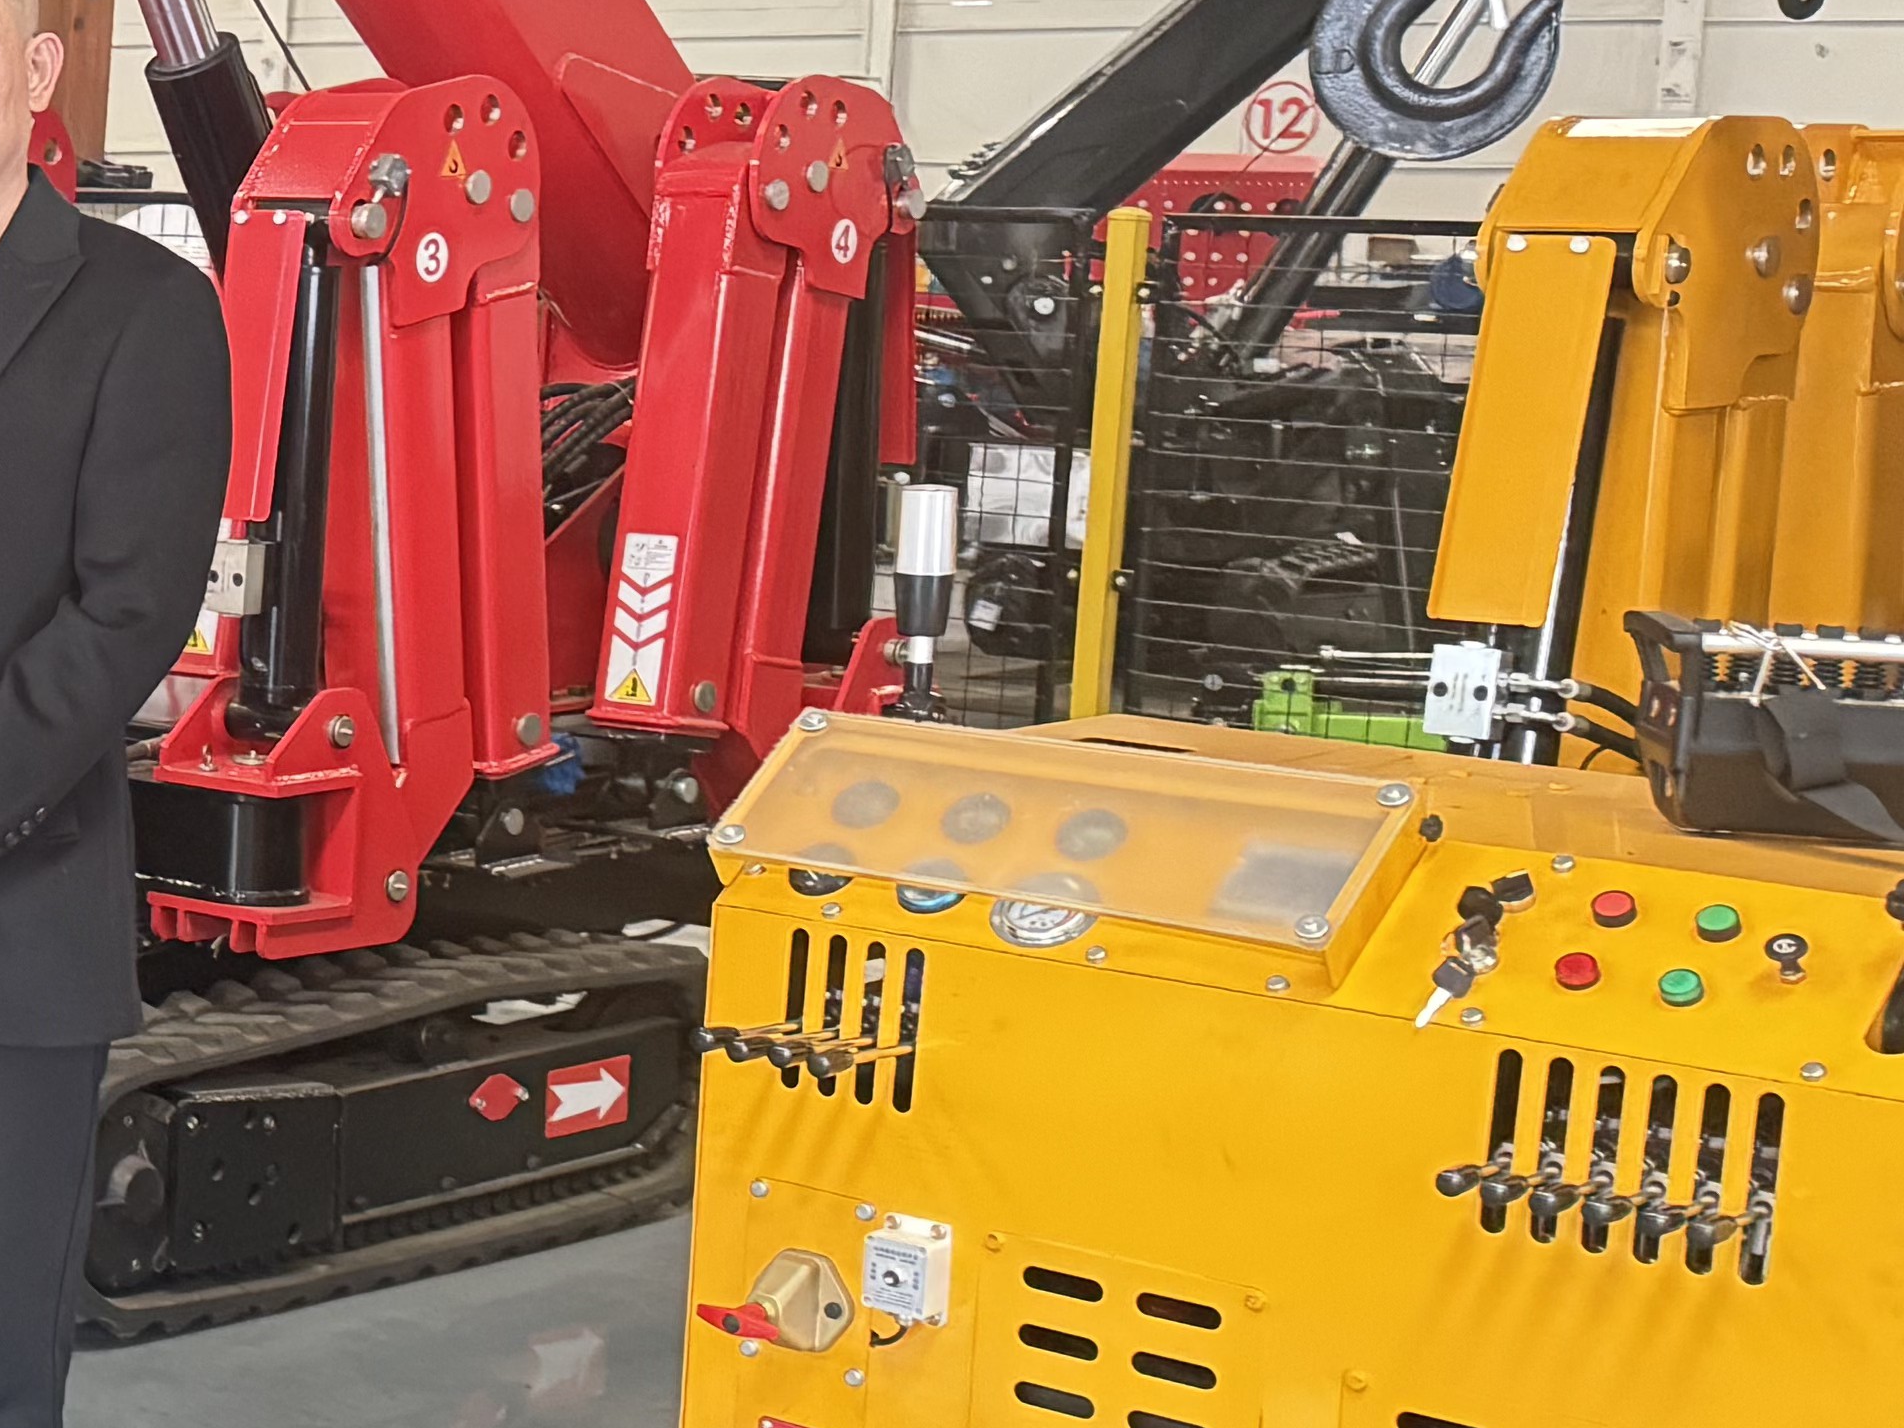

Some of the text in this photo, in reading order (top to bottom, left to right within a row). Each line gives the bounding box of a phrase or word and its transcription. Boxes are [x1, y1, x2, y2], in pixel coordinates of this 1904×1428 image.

[1254, 96, 1309, 140] 12
[423, 238, 441, 276] 3
[834, 224, 851, 259] 4
